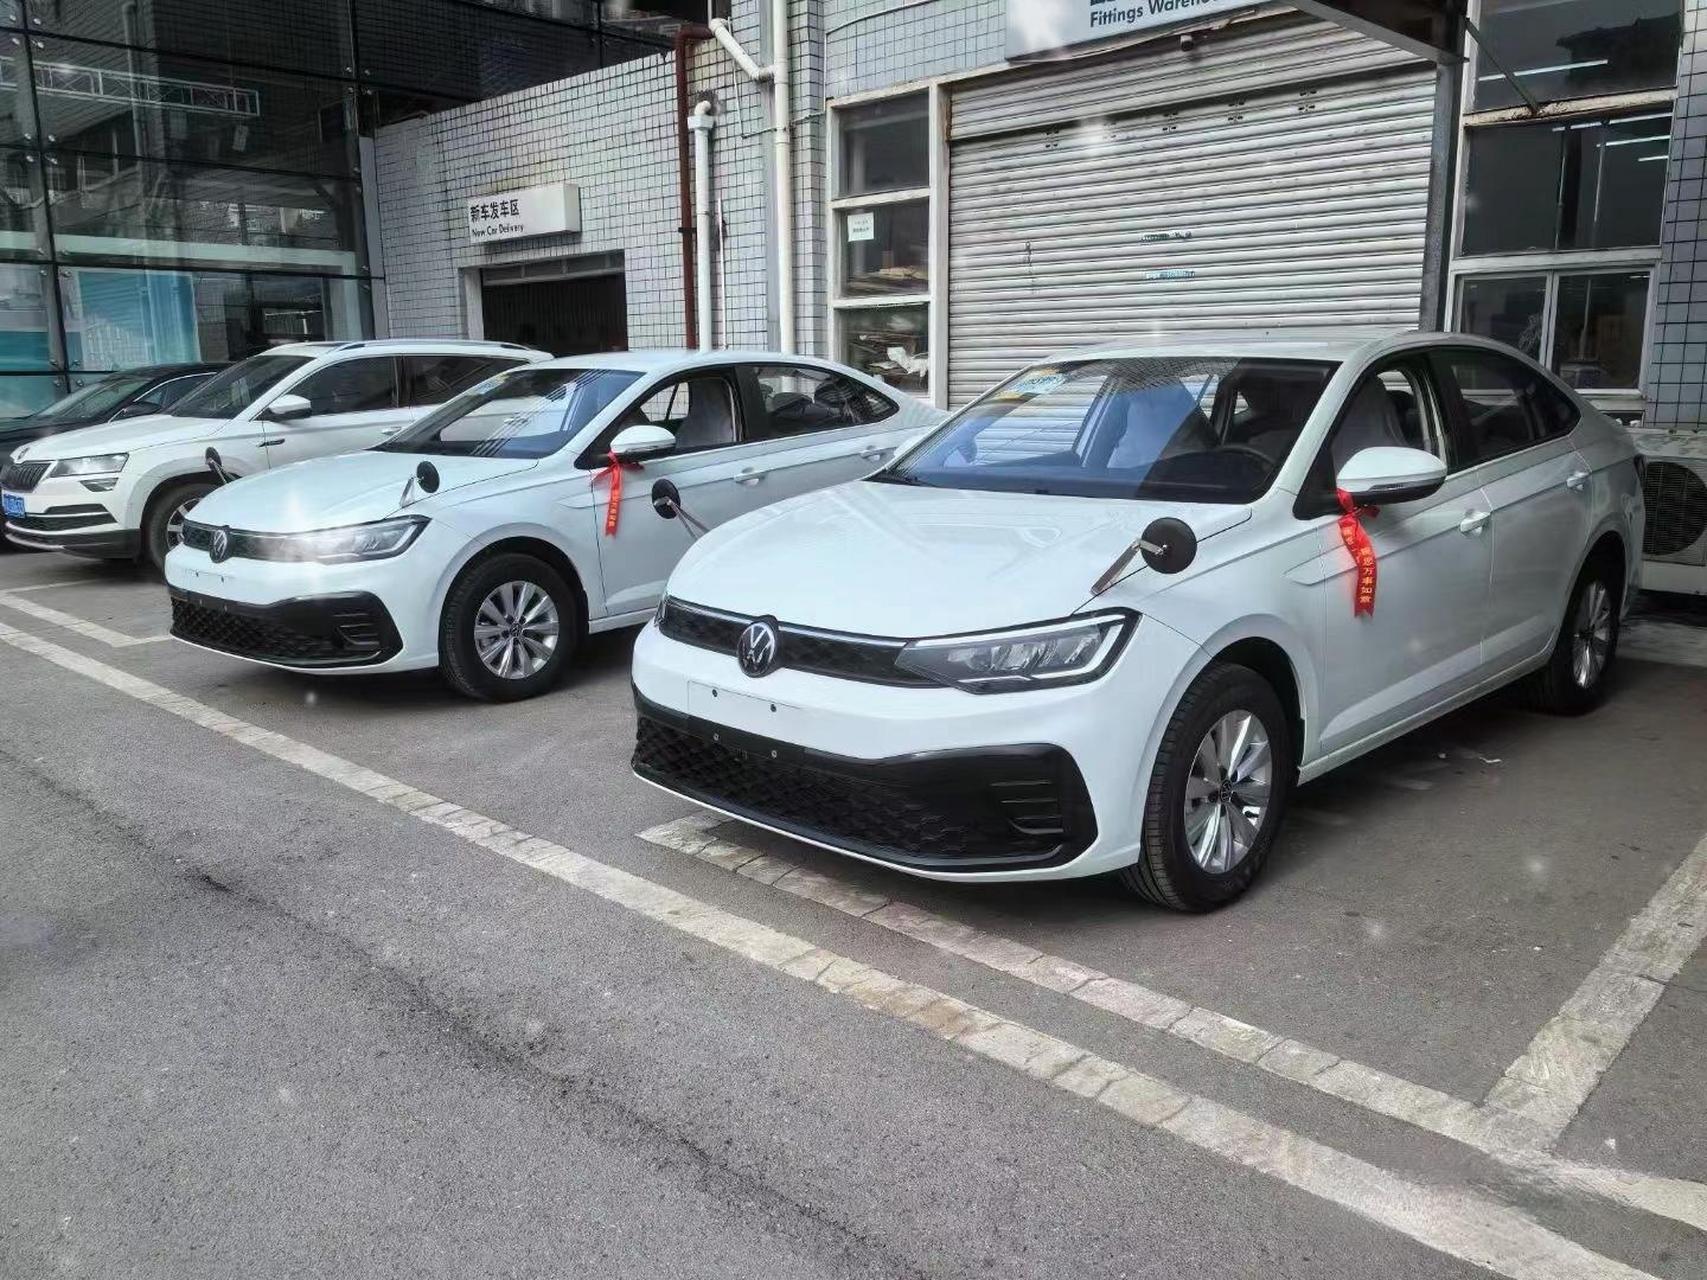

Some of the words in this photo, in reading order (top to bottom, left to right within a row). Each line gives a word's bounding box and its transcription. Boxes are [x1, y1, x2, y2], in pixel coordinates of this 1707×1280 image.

[1090, 7, 1143, 27] Fittings
[1148, 0, 1210, 14] Ware
[470, 199, 519, 222] 新车发车区
[487, 225, 498, 236] Car
[499, 223, 524, 233] Delivery
